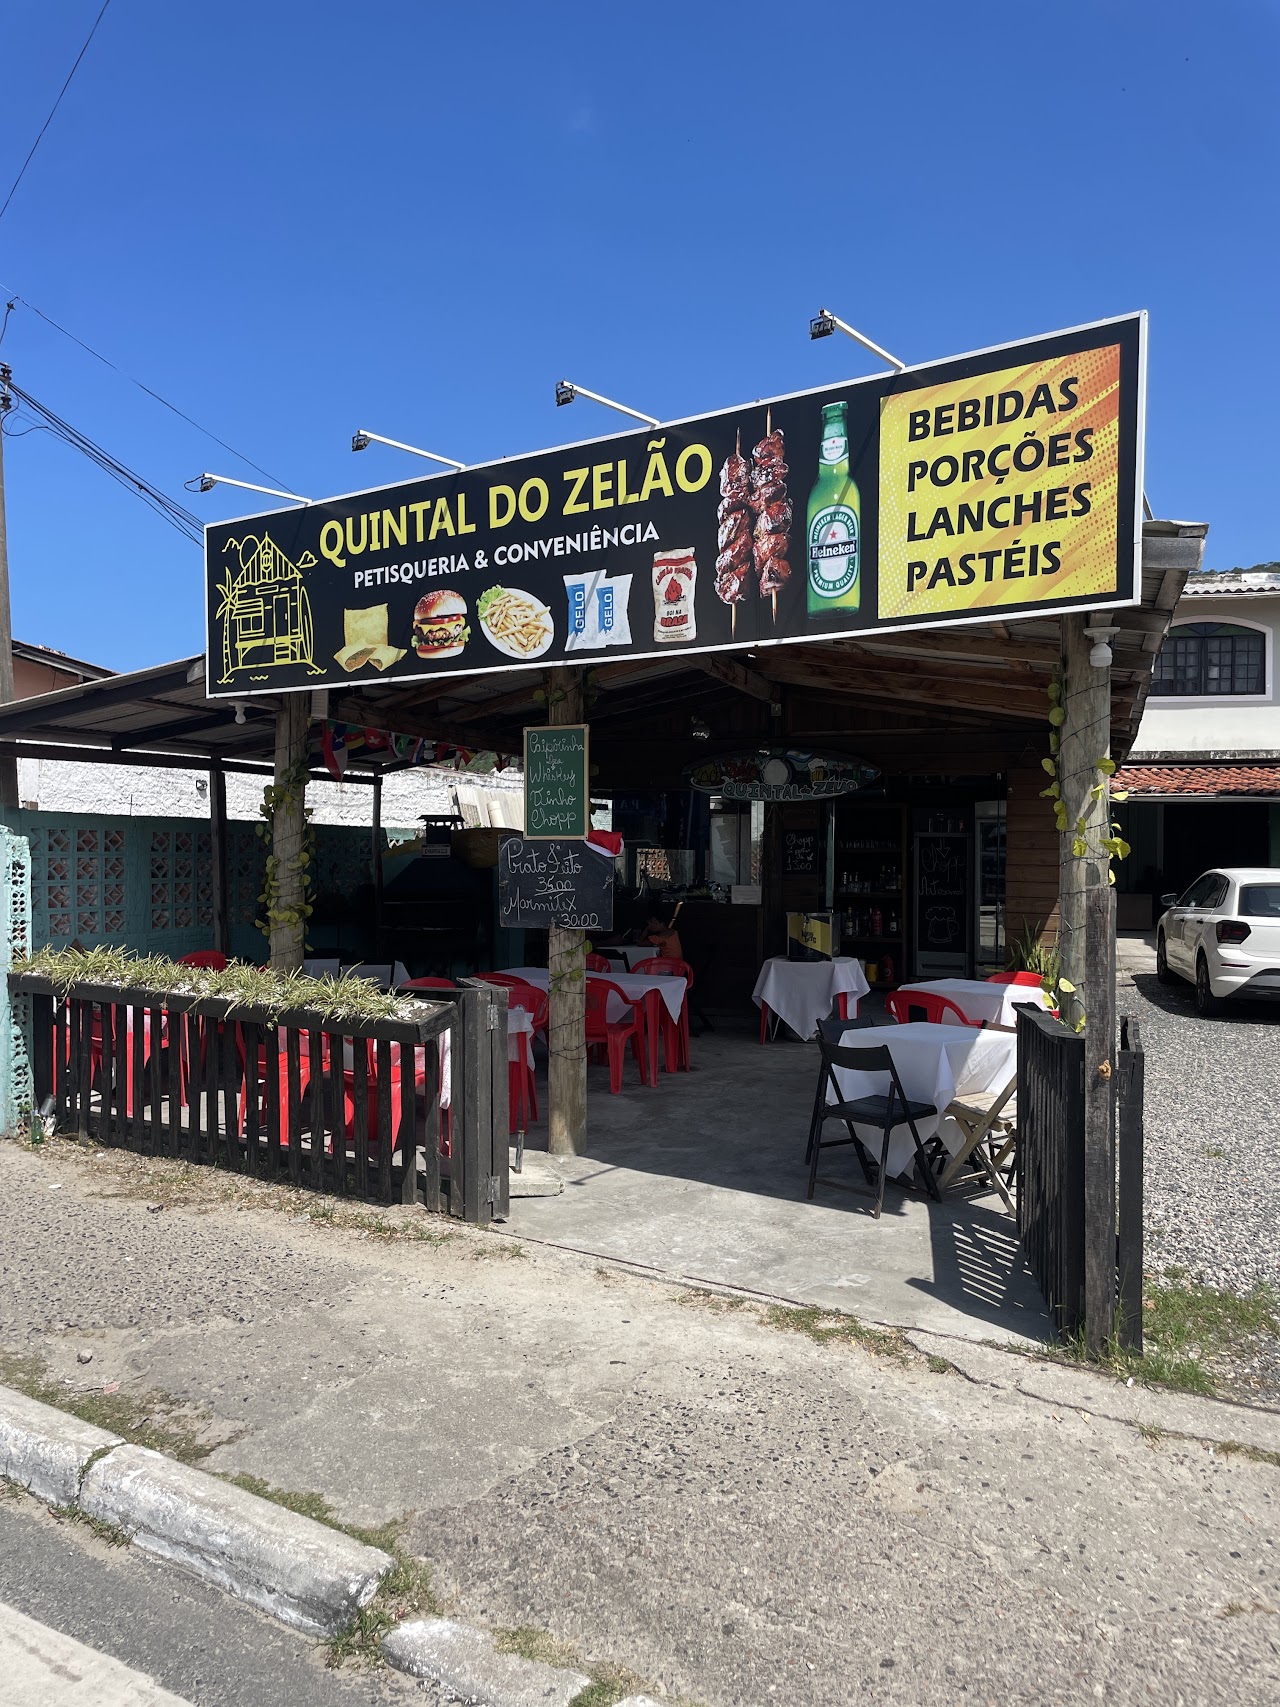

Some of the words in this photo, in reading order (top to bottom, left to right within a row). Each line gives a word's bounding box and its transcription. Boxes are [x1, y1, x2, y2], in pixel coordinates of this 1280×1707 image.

[908, 377, 1079, 443] BEBIDAS
[907, 428, 1094, 493] PORÇÕES
[319, 493, 477, 568] QUINTAL
[489, 477, 550, 529] DO
[562, 437, 713, 516] ZELÃO
[907, 482, 1092, 543] LANCHES
[354, 553, 470, 589] PETISQUERIA
[474, 549, 489, 569] &
[493, 521, 660, 567] CONVENIÊNCIA
[812, 543, 856, 559] Heineken
[906, 539, 1061, 593] PASTÉIS
[575, 591, 585, 629] GELO
[604, 593, 613, 627] GELO
[661, 614, 688, 627] BRASA
[723, 781, 804, 800] QUINTAL
[531, 808, 577, 831] Chopp
[501, 838, 548, 874] Prato
